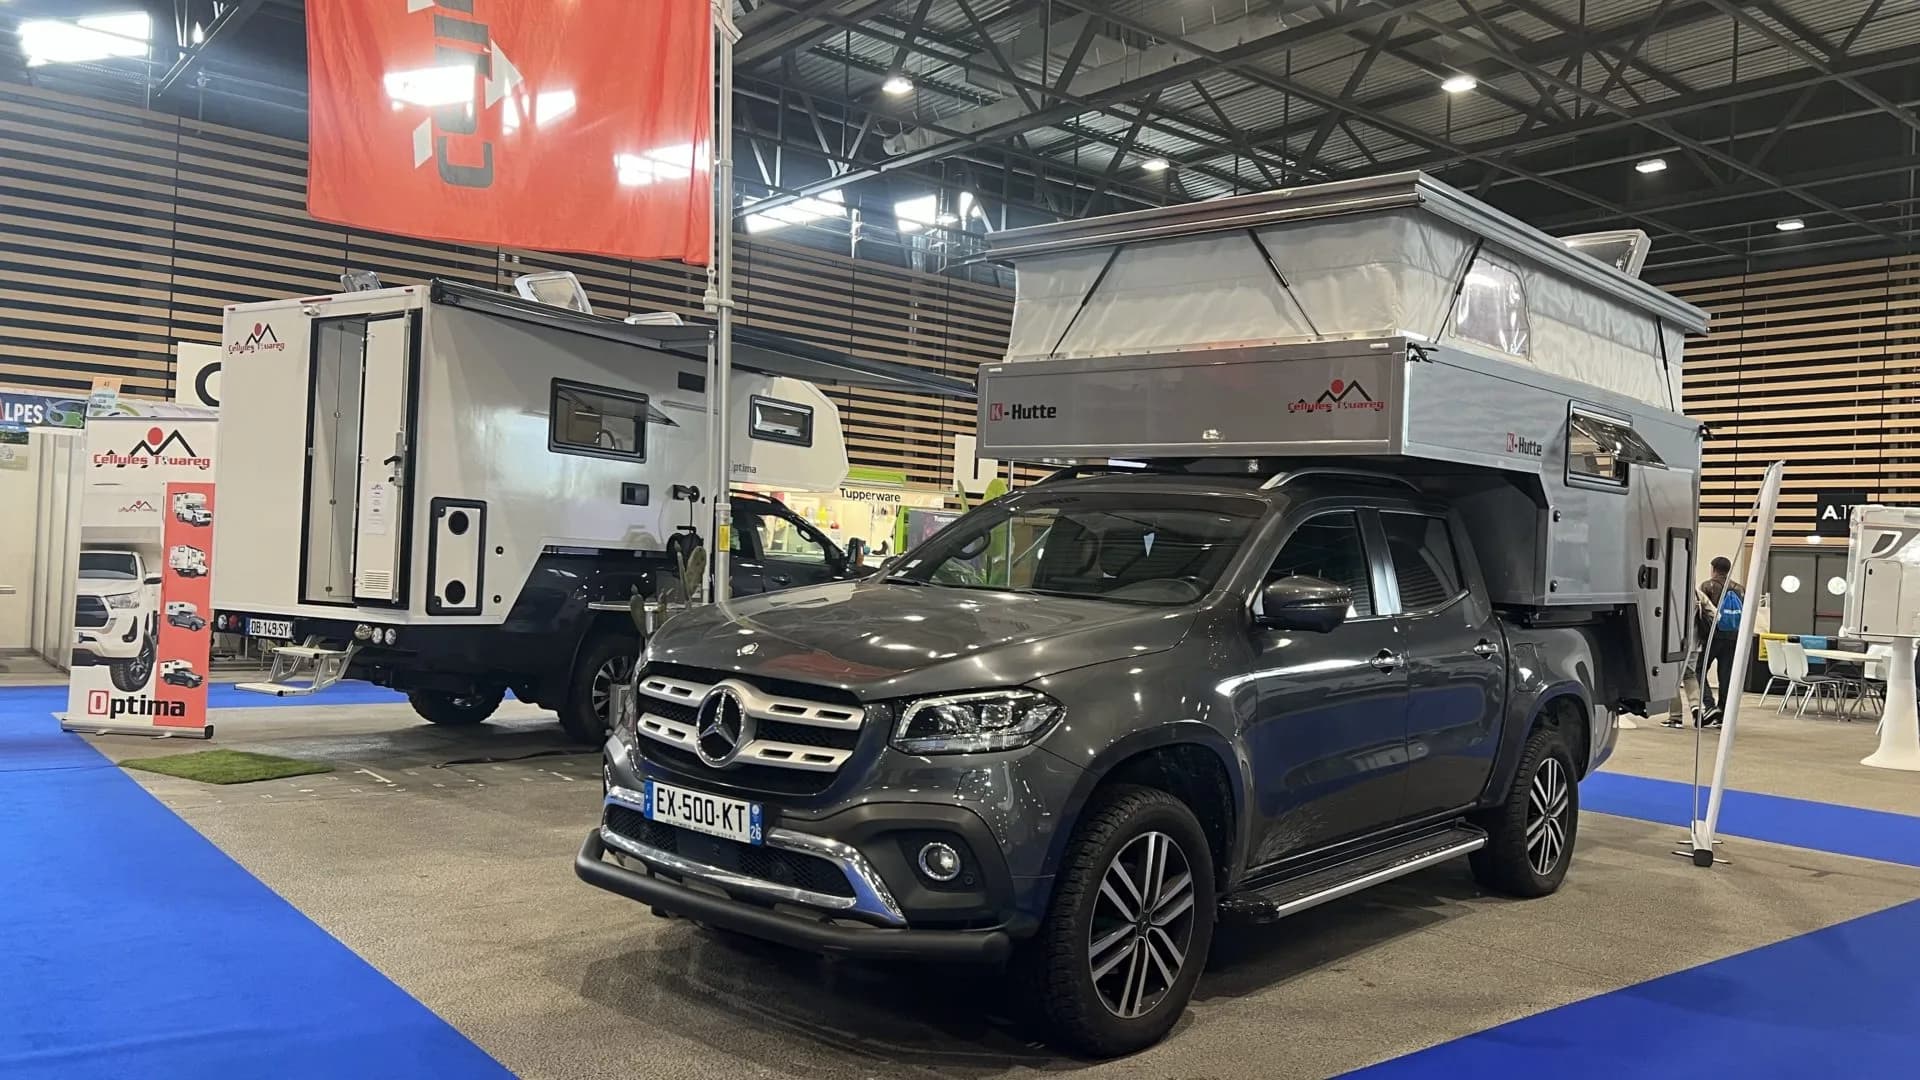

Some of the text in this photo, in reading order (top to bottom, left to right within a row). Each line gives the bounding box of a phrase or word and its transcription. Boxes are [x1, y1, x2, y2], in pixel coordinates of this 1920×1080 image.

[990, 403, 1057, 421] K-Hutte
[1287, 401, 1333, 412] Cellules
[1506, 432, 1543, 457] K-Hutte
[93, 454, 148, 467] Cellules
[839, 487, 901, 502] Tupperware
[88, 689, 186, 719] Optima
[656, 787, 746, 833] EX-500-KT
[750, 824, 762, 841] 26
